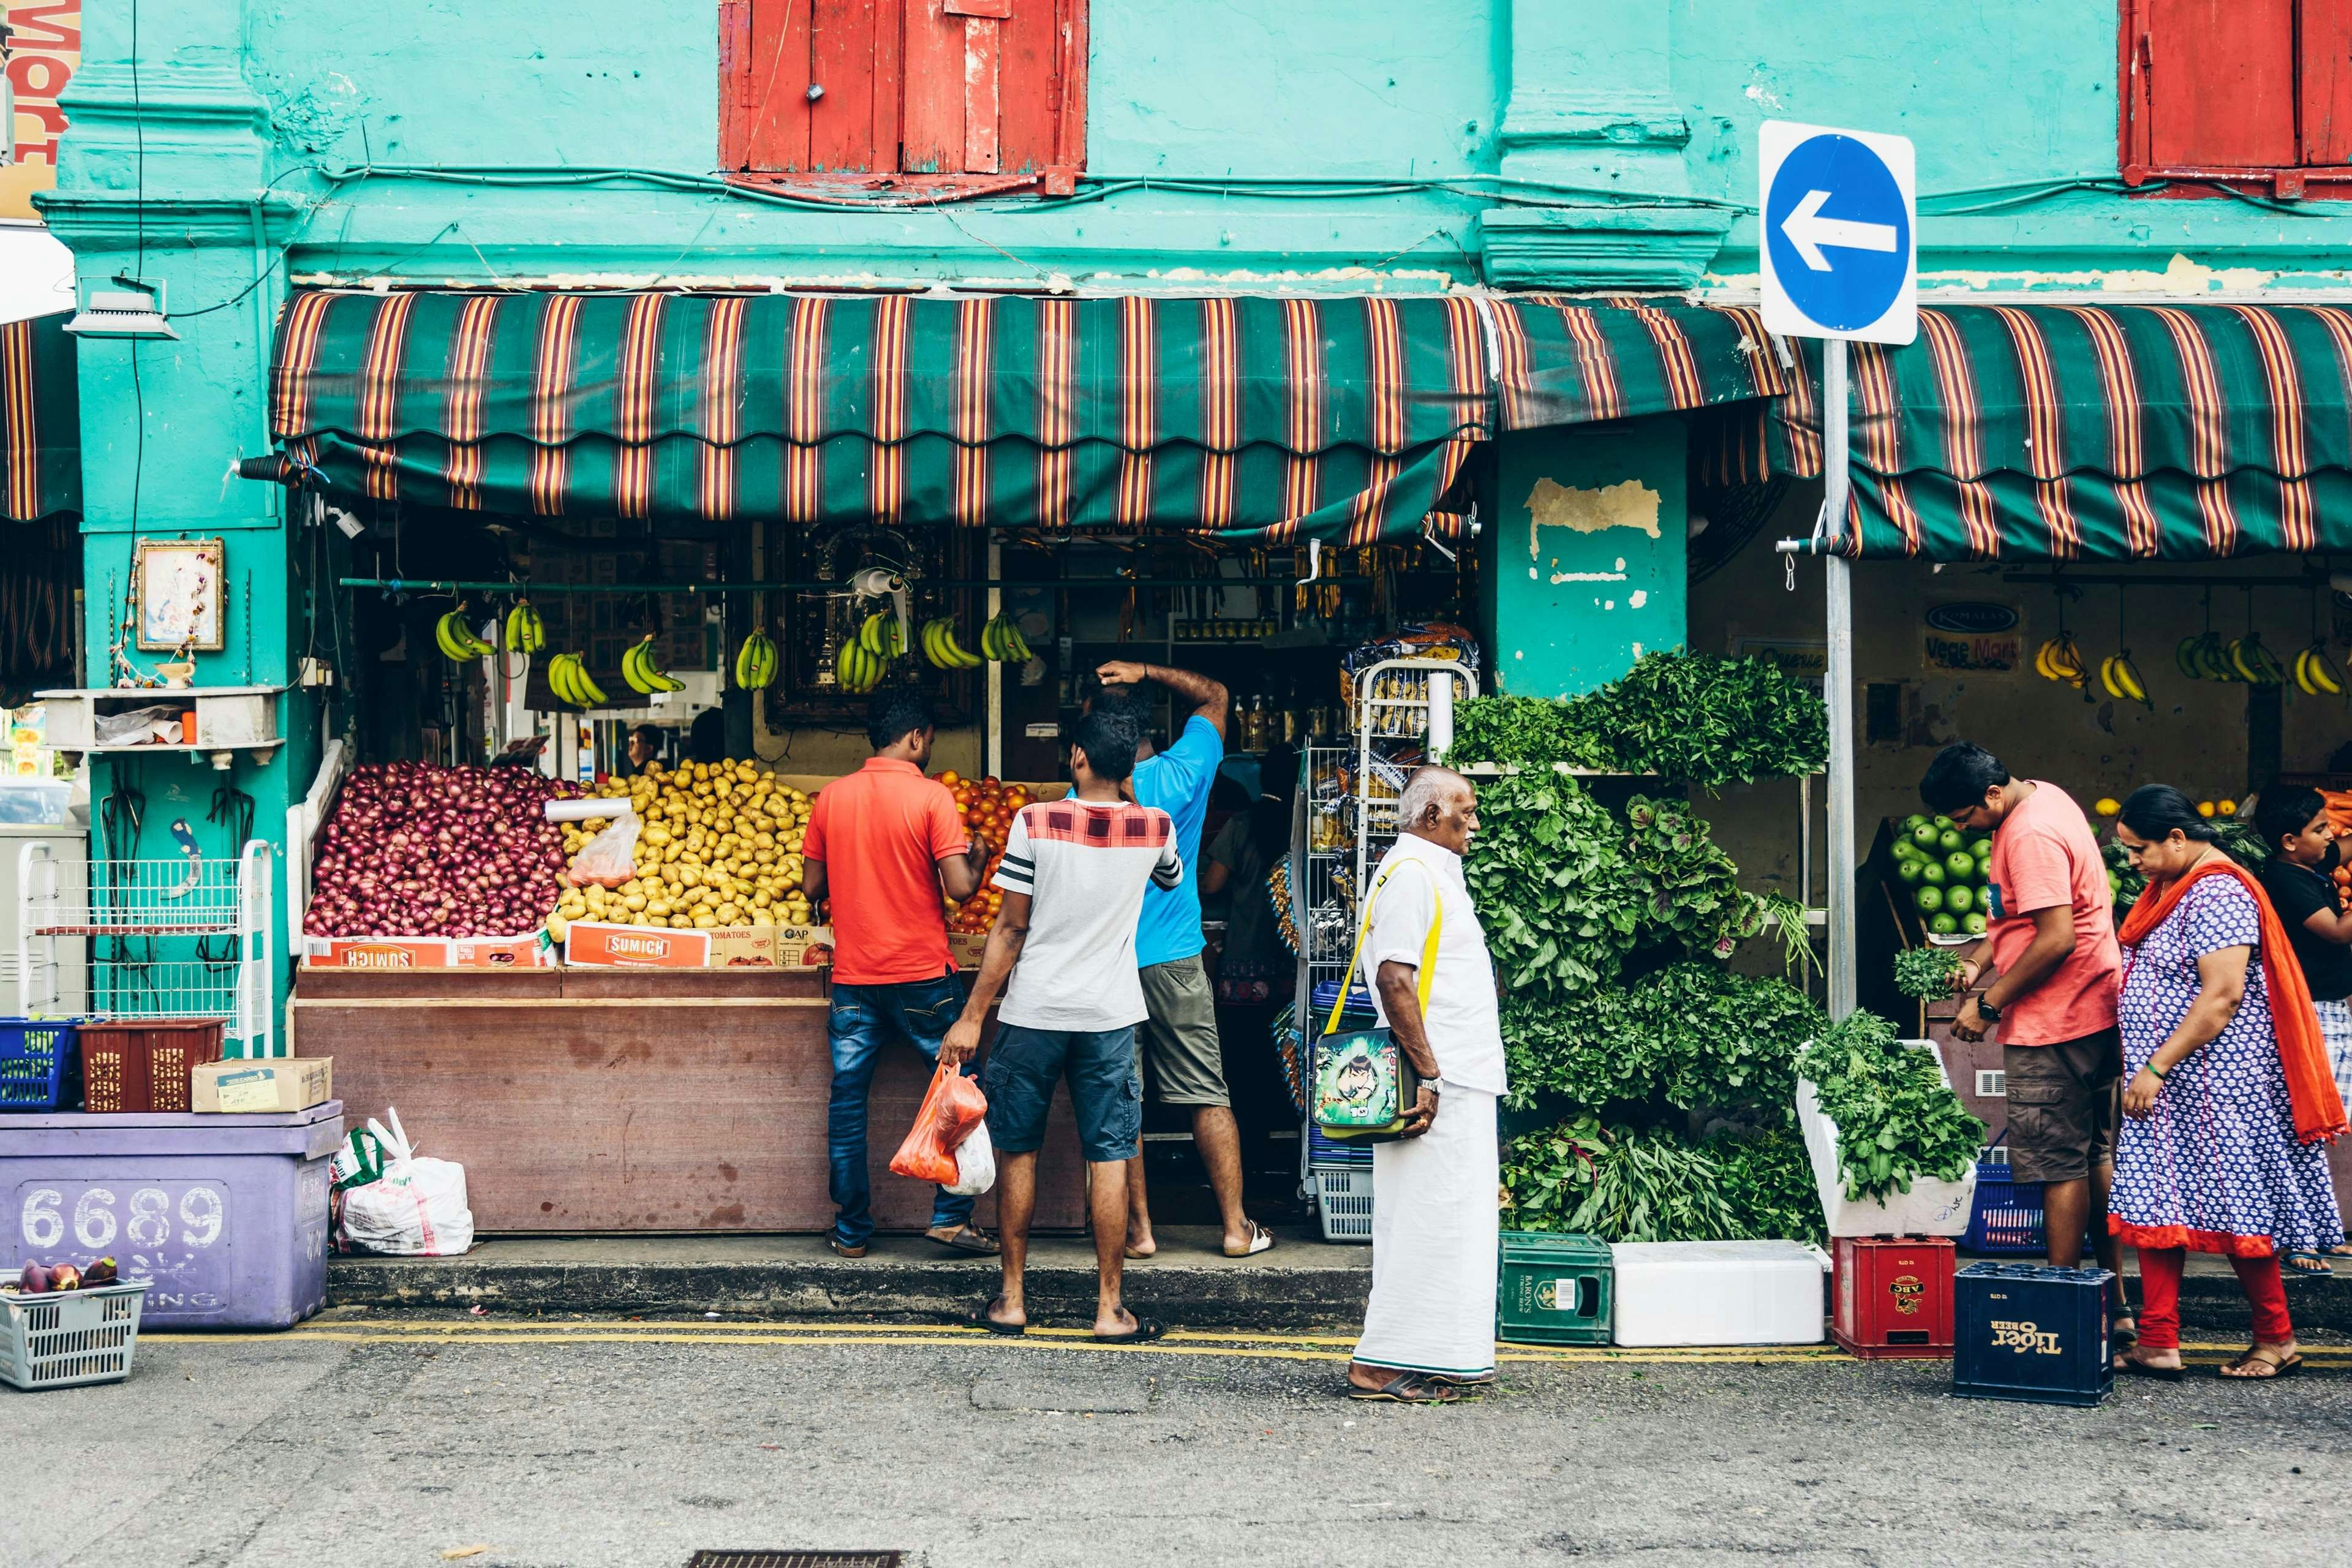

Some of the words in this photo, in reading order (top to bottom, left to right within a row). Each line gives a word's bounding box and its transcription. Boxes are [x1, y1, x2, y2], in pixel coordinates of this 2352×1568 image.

[709, 930, 752, 940] TOMATOES
[611, 937, 665, 956] SUMICH
[1350, 1107, 1369, 1118] 10
[22, 1187, 223, 1249] 6689
[1523, 1275, 1532, 1314] BARON'S
[1990, 1321, 2019, 1330] BEER
[1991, 1321, 2062, 1355] Tiger
